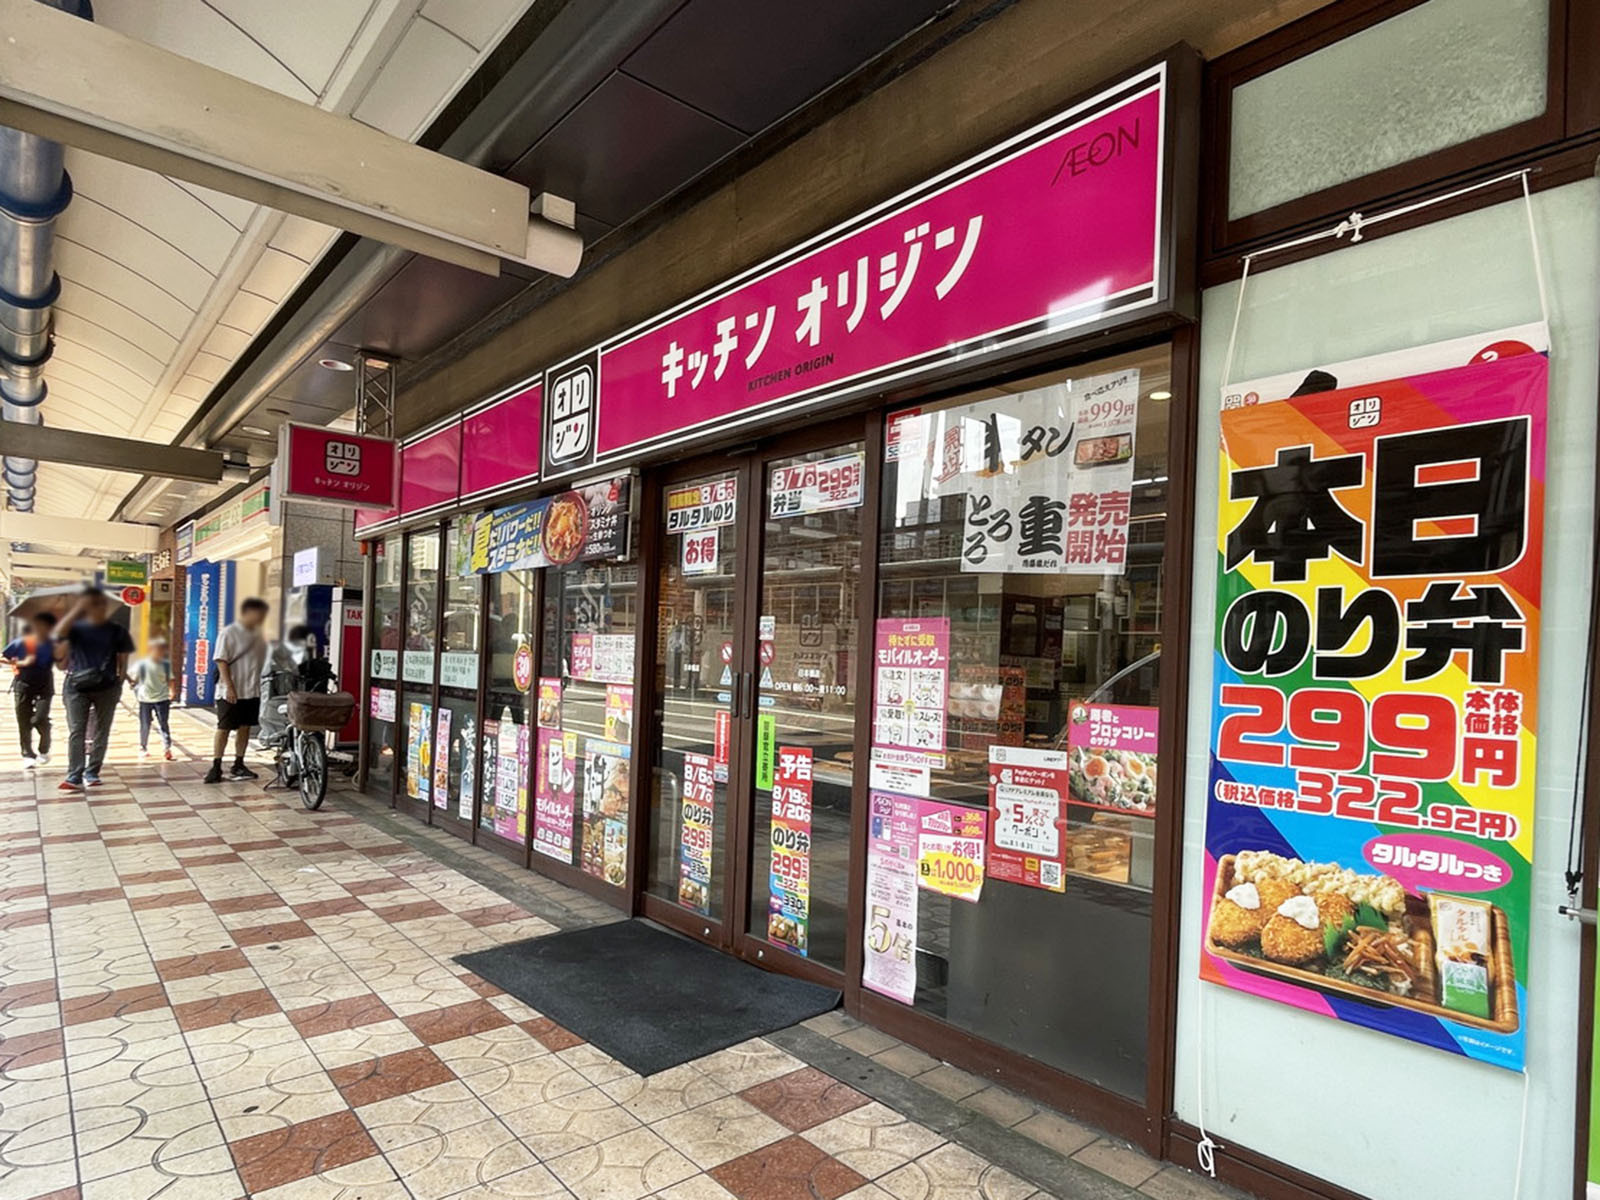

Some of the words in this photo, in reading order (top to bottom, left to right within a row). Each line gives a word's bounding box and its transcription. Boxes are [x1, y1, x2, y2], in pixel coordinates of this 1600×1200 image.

[660, 304, 777, 400] キッチン
[795, 215, 984, 347] オリジン
[747, 368, 791, 392] KITCHEN
[794, 353, 835, 376] ORIGIN
[772, 490, 803, 513] 弁当
[1068, 490, 1131, 527] 発売
[1224, 414, 1531, 582] 本日
[669, 502, 734, 529] タルタルのり
[685, 536, 716, 565] お得
[1065, 528, 1127, 564] 開始
[1221, 581, 1526, 685] のり弁
[878, 647, 946, 667] モバイルオーダー
[1089, 724, 1156, 741] ブロッコリー
[780, 754, 812, 781] 予告
[683, 803, 712, 825] のり弁
[1214, 770, 1519, 839] (税込価格322.92円)
[773, 827, 809, 853] のり弁
[772, 852, 802, 880] 299
[1371, 842, 1503, 883] タルタルつき
